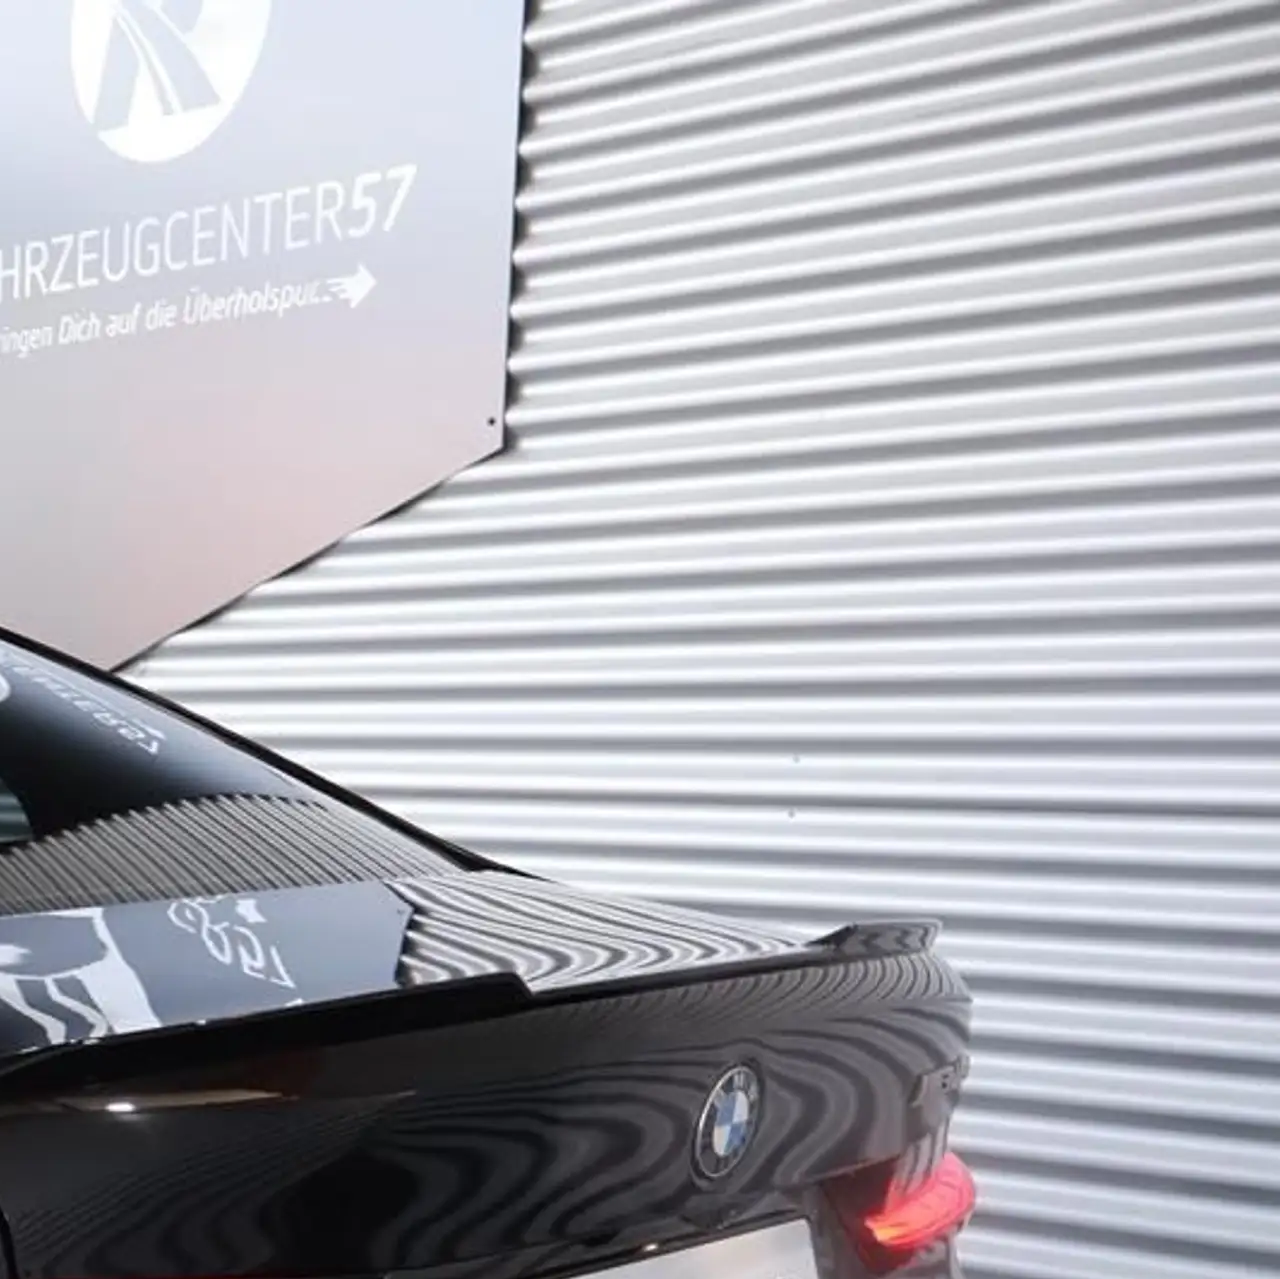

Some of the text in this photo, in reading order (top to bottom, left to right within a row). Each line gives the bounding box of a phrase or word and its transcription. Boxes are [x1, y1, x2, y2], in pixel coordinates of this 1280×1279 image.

[58, 308, 101, 344] Dich
[106, 302, 141, 337] auf
[144, 299, 178, 330] die
